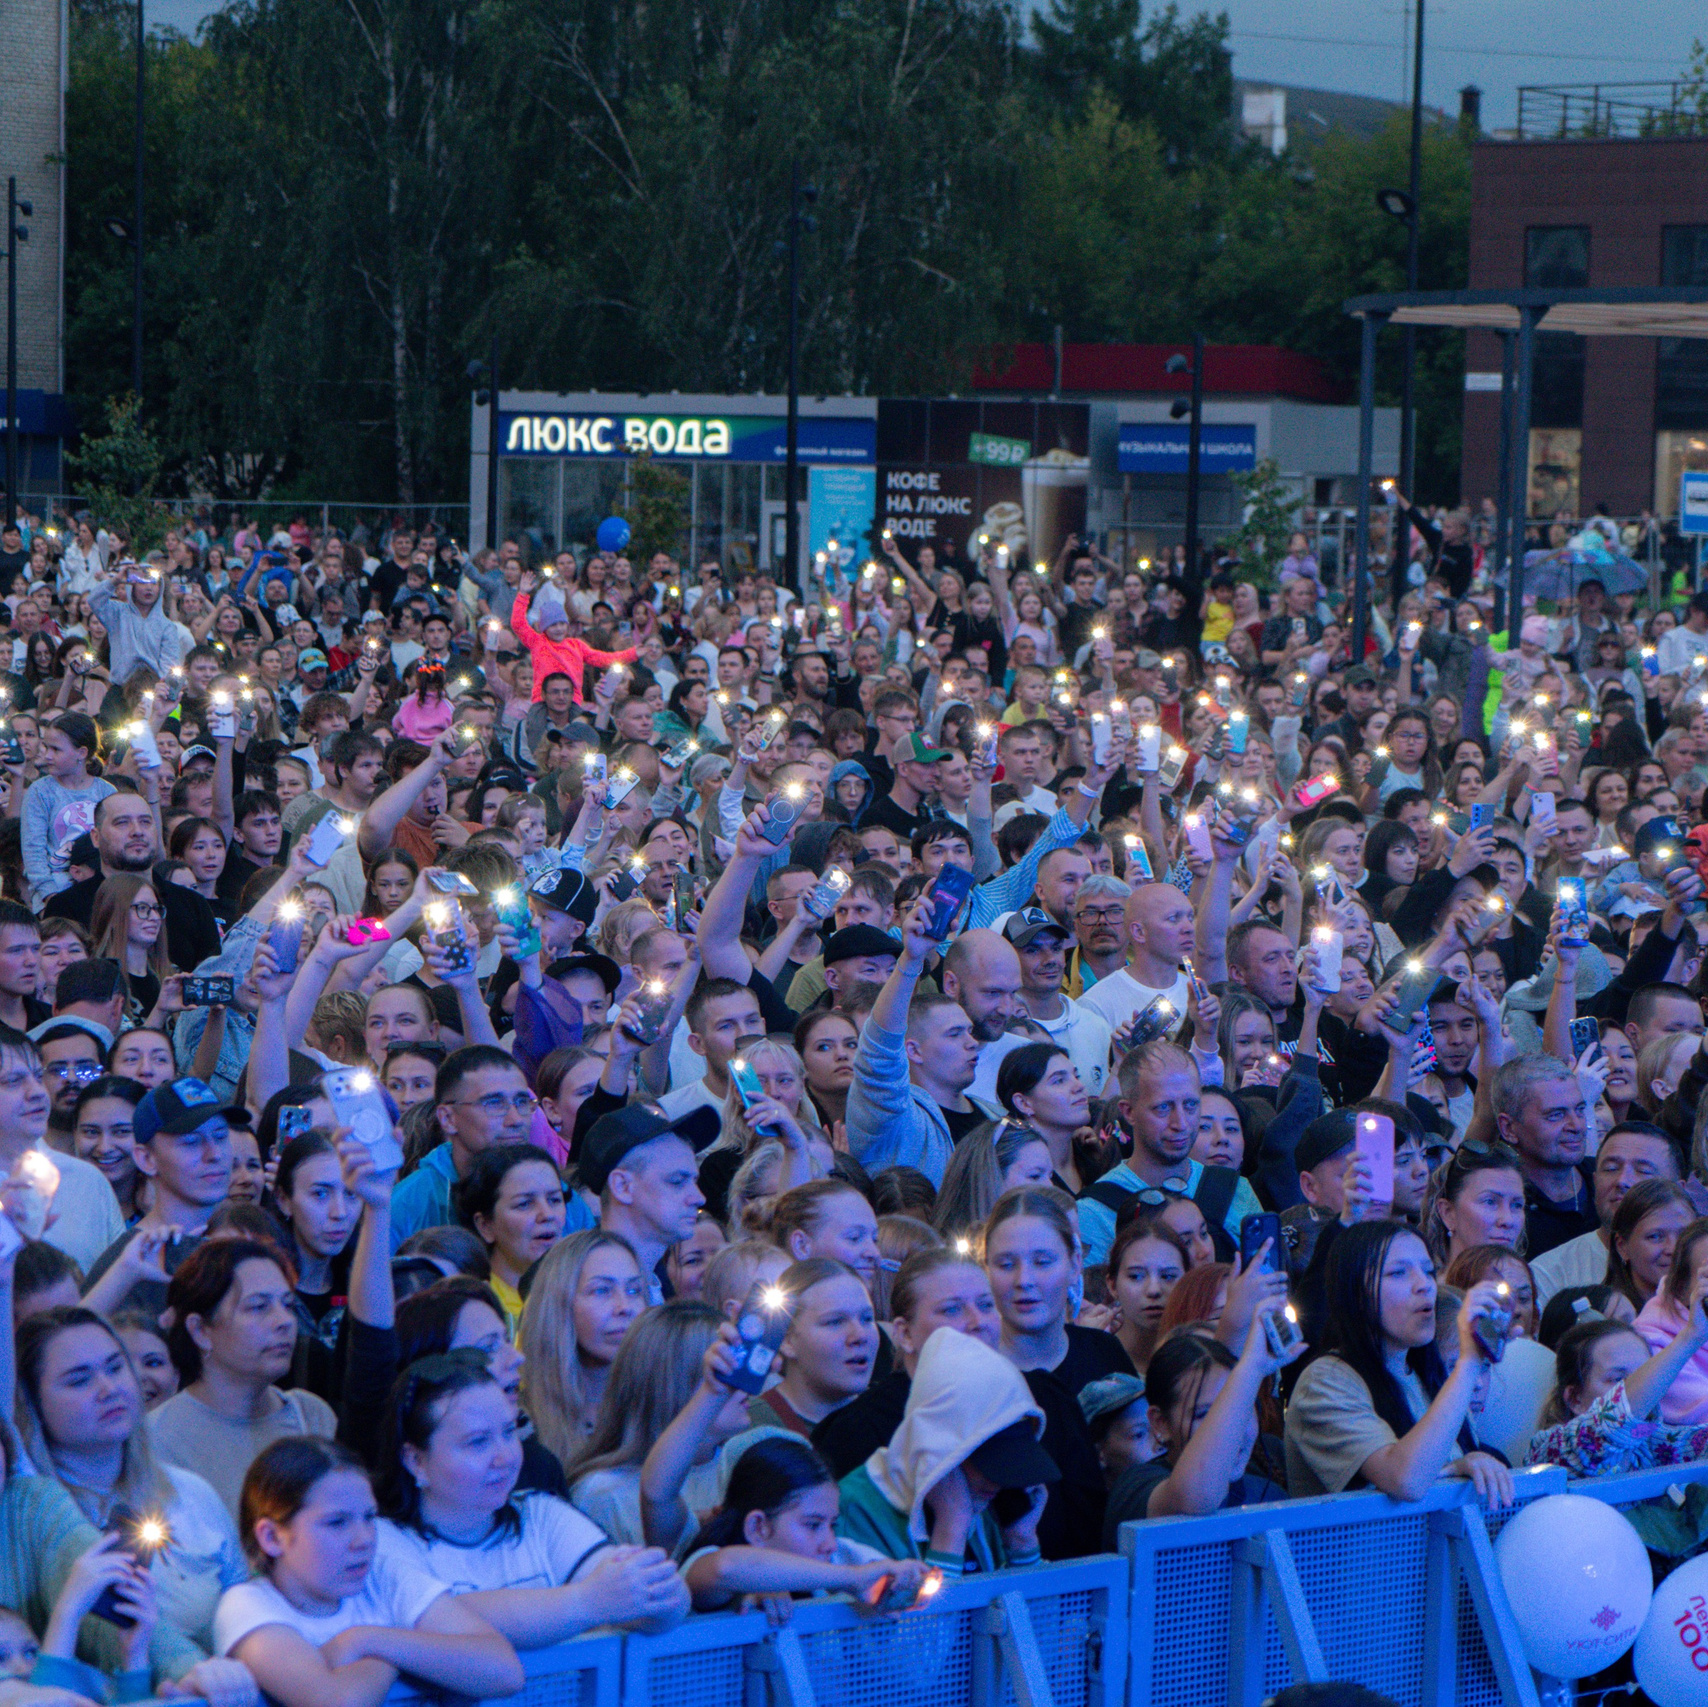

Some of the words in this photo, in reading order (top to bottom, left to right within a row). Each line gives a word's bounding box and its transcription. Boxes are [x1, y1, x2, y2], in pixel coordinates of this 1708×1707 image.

[1206, 442, 1253, 455] ШКОЛА
[887, 471, 941, 491] КОФЕ
[886, 494, 913, 513] НА
[915, 495, 973, 516] ЛЮКС
[885, 517, 938, 538] ВОДЕ
